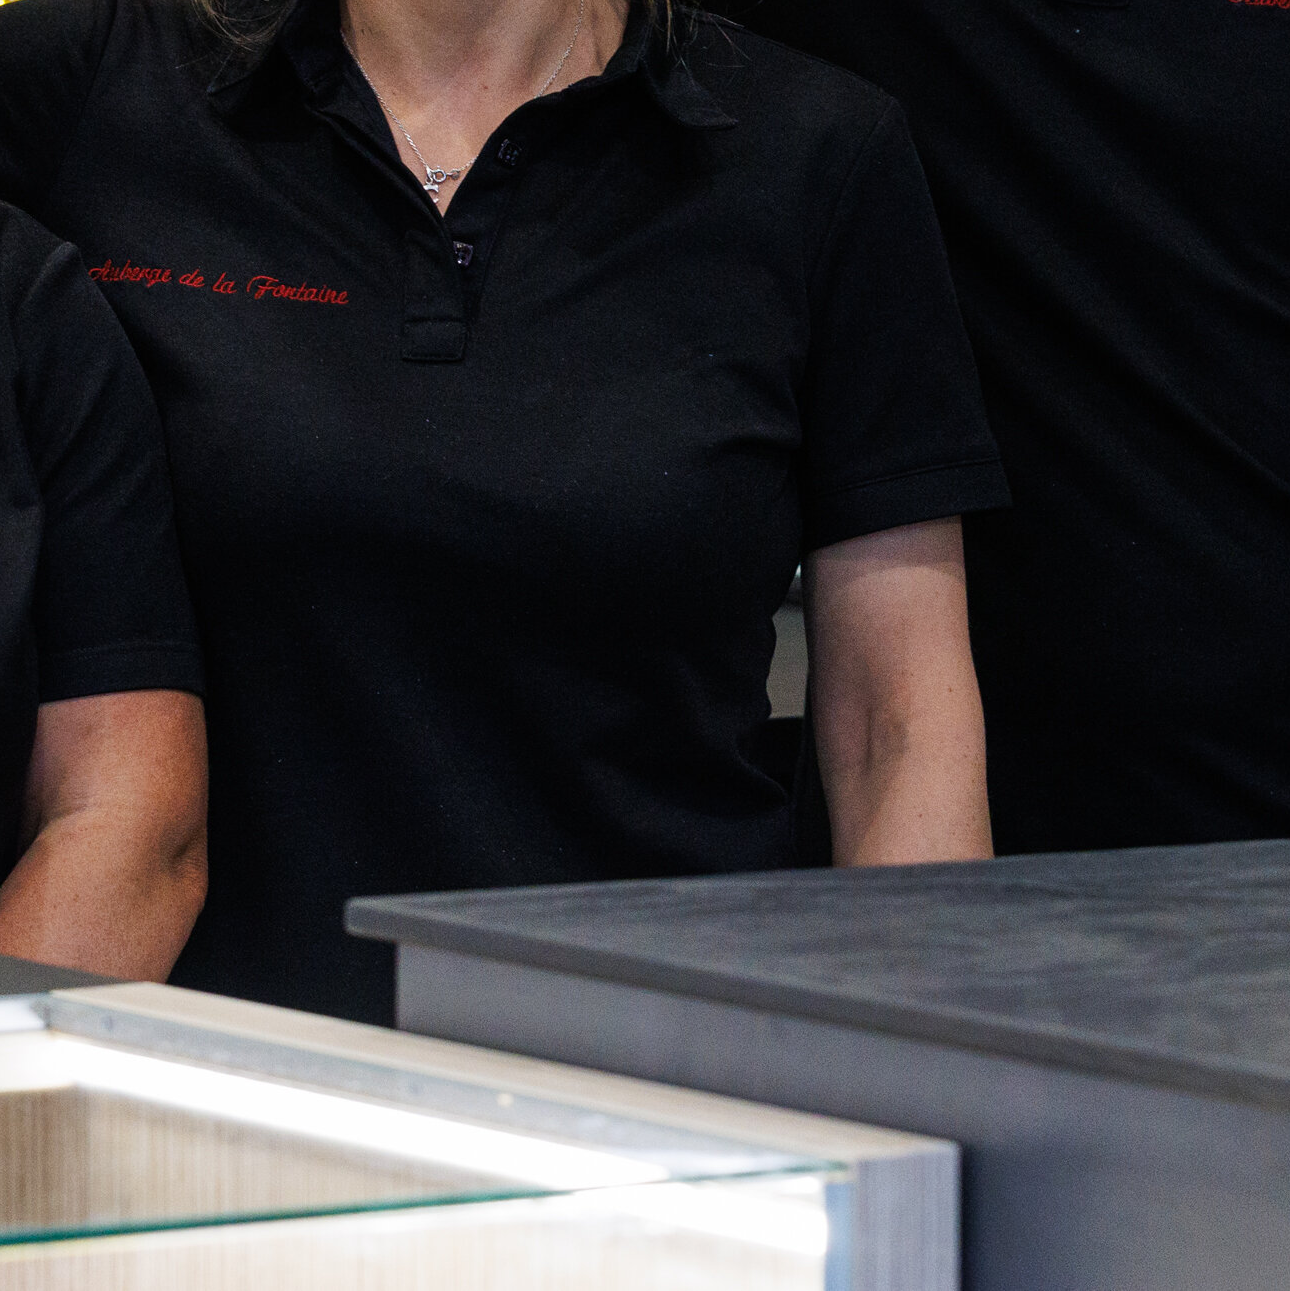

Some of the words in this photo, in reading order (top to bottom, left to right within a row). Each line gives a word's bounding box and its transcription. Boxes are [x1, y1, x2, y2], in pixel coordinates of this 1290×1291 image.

[88, 259, 172, 288] Auberge
[179, 269, 205, 287] de
[212, 272, 237, 294] la
[247, 275, 349, 305] Fontaine
